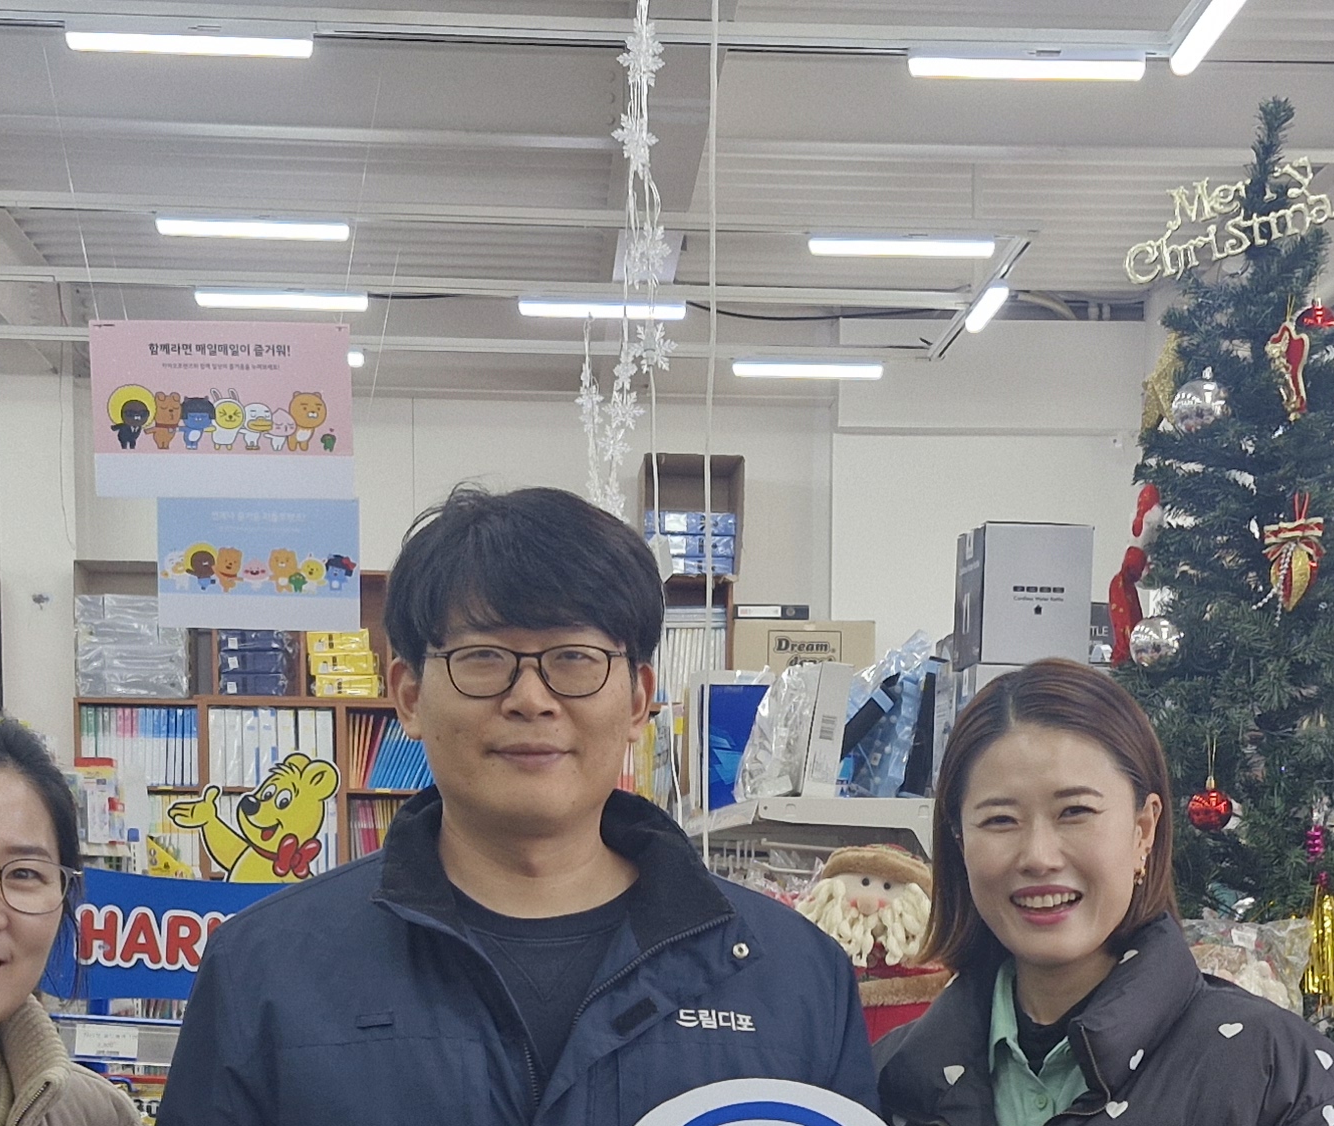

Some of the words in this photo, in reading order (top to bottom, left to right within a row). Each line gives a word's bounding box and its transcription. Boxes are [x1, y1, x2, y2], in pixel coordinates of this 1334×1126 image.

[148, 342, 193, 357] 함께라면
[195, 343, 251, 357] 매일매일이
[253, 344, 291, 358] 즐거워!
[774, 636, 836, 654] Dream
[675, 1008, 757, 1032] 드림디포
